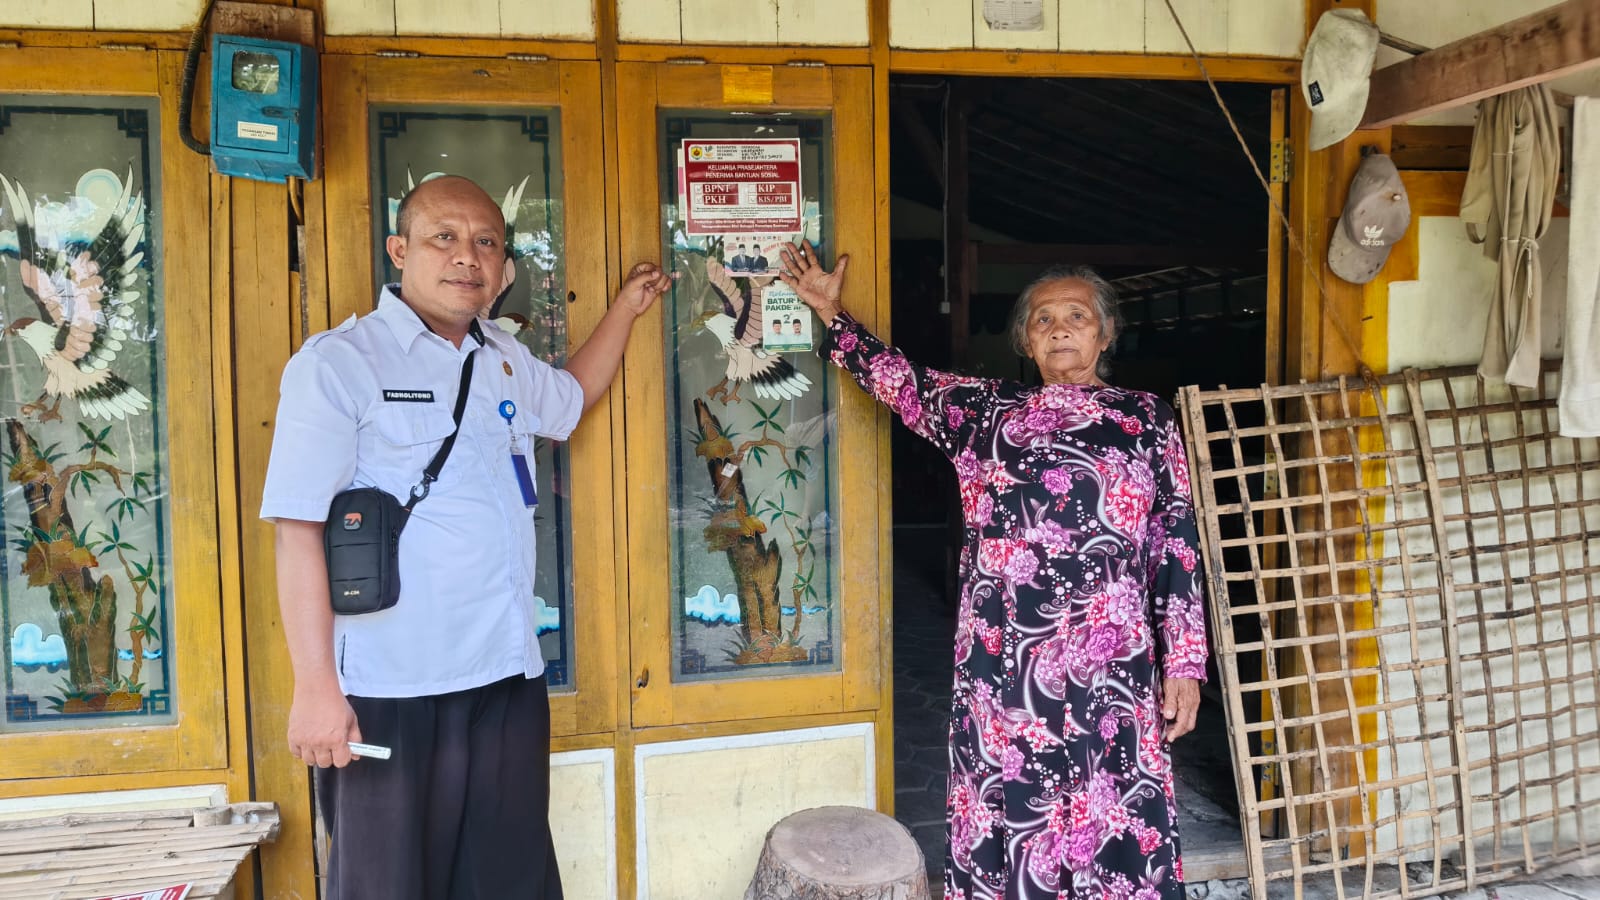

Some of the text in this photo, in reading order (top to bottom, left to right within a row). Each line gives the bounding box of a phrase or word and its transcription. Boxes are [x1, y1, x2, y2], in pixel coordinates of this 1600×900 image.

[758, 184, 776, 193] KIP
[704, 195, 727, 204] PKH
[783, 314, 791, 324] 2
